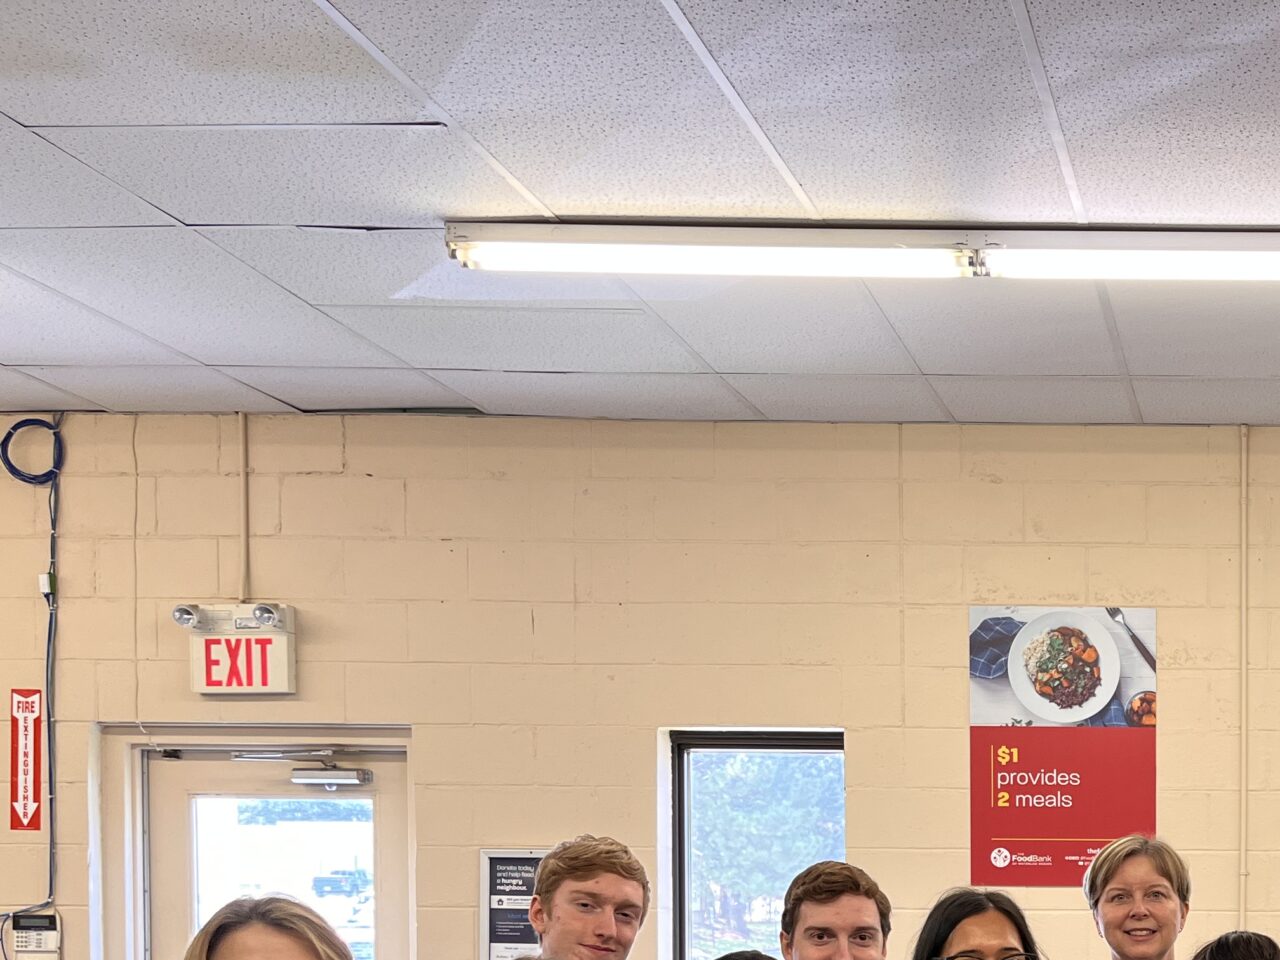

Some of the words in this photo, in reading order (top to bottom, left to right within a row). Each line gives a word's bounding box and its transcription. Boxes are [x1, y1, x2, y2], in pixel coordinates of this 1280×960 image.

[205, 638, 272, 687] EXIT
[17, 701, 35, 713] FIRE
[997, 745, 1019, 765] $1
[997, 769, 1081, 789] provides
[997, 791, 1010, 807] 2
[1015, 791, 1073, 807] meals
[517, 864, 535, 872] today
[501, 877, 523, 885] hungry
